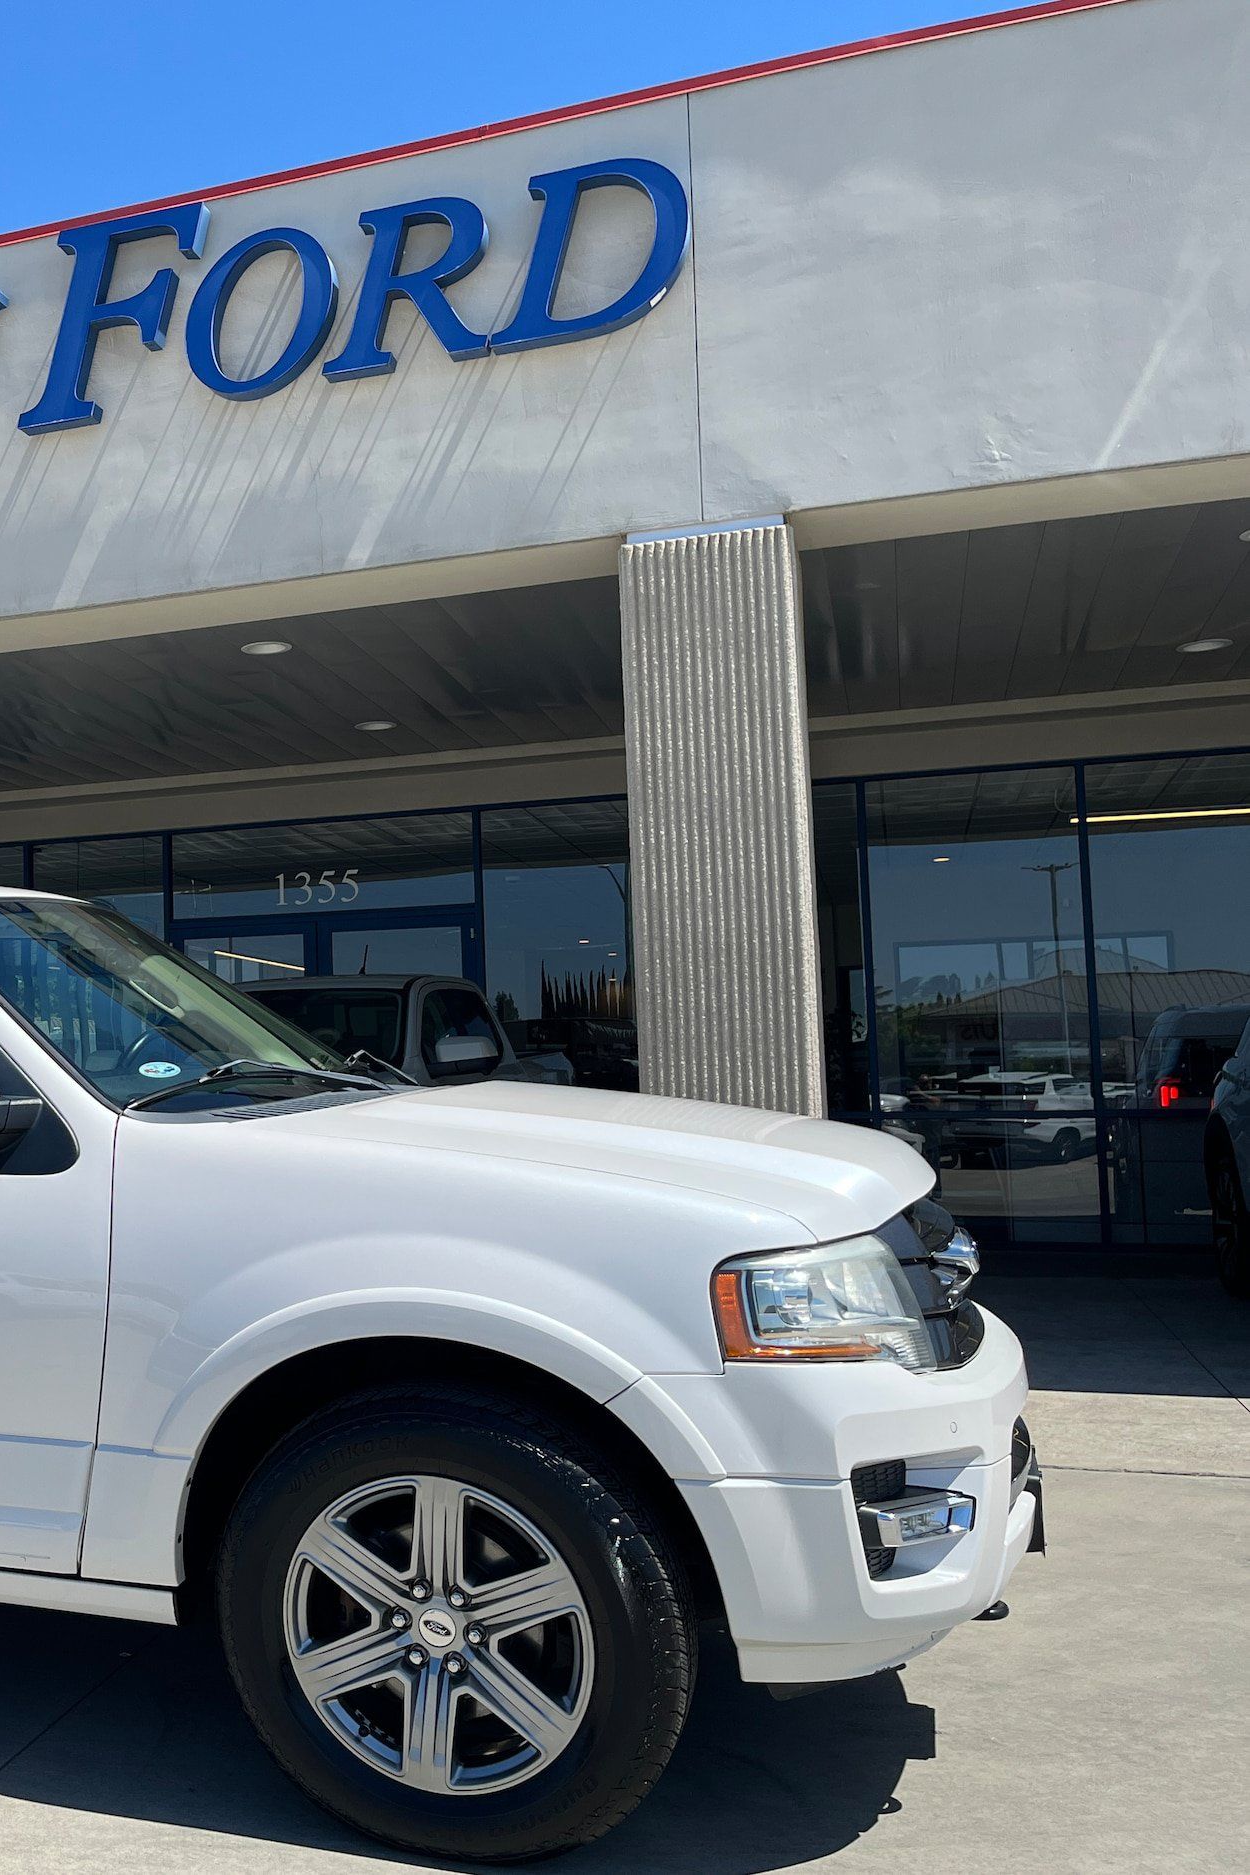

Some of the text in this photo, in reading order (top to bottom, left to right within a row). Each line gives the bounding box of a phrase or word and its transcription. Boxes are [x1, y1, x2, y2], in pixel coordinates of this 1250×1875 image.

[17, 157, 693, 436] FORD
[275, 868, 359, 906] 1355
[426, 1621, 449, 1636] Ford
